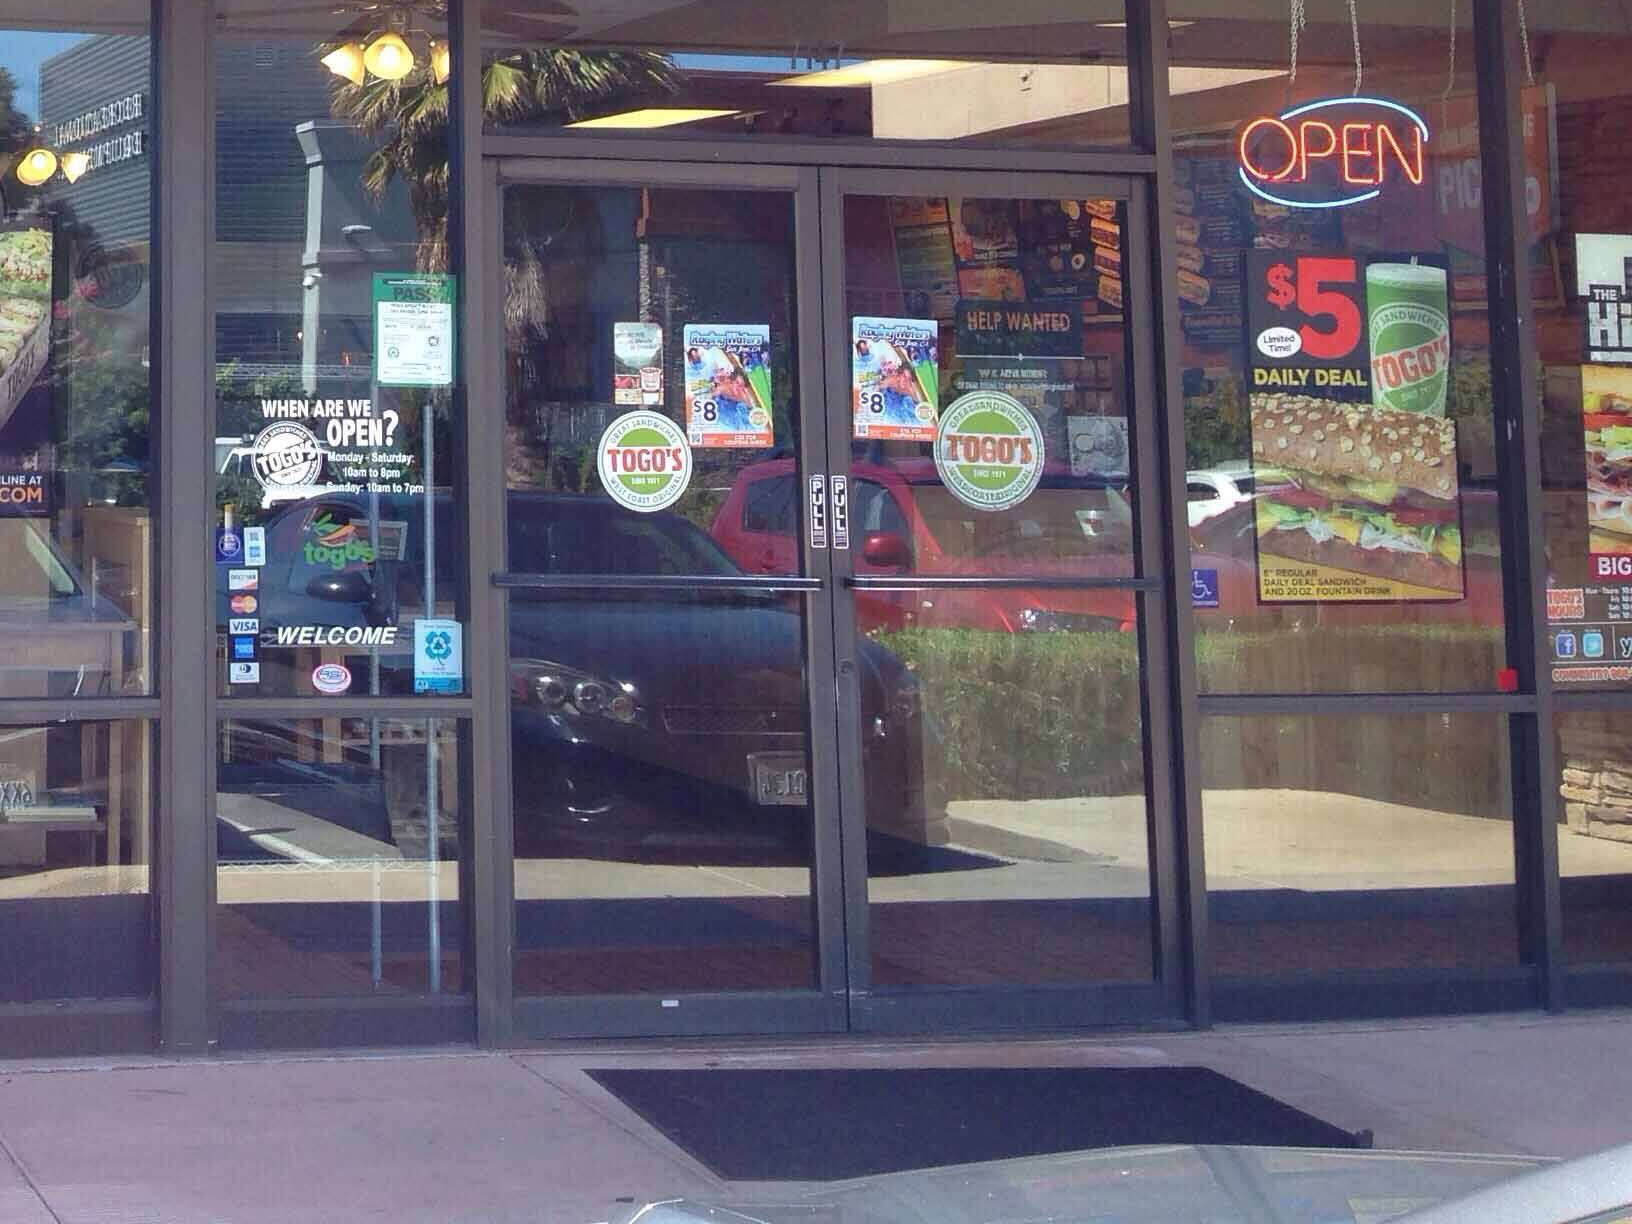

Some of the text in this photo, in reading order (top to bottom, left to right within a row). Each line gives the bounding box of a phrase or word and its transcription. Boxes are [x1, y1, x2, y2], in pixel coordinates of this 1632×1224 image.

[1240, 118, 1425, 184] OPEN
[1593, 289, 1617, 301] THE
[1266, 258, 1361, 360] $5
[968, 311, 1070, 332] HELP WANTED
[1254, 369, 1367, 386] DAILY DEAL
[262, 400, 371, 418] WHEN ARE WE
[327, 410, 398, 447] OPEN?
[257, 440, 317, 475] TOGO'S
[327, 451, 364, 464] Monday
[945, 435, 1032, 464] TOGO'S
[608, 448, 682, 472] TOGO'S
[28, 476, 42, 485] AT
[343, 466, 400, 480] 10am to 8pm
[327, 481, 424, 495] Sunday: 10am to 7pm
[812, 481, 823, 529] PULL
[835, 482, 845, 530] PULL
[1276, 569, 1318, 577] REGULAR
[1598, 556, 1632, 576] BIG
[1264, 578, 1366, 587] DAILY DEAL SANDWICH
[1265, 587, 1285, 596] AND
[1287, 587, 1297, 596] 20
[1316, 586, 1362, 596] FOUNTAIN
[1363, 586, 1392, 595] DRINK
[1547, 589, 1584, 605] TOGO'S
[1548, 604, 1585, 618] HOURS
[232, 621, 257, 631] VISA
[277, 626, 398, 645] WELCOME
